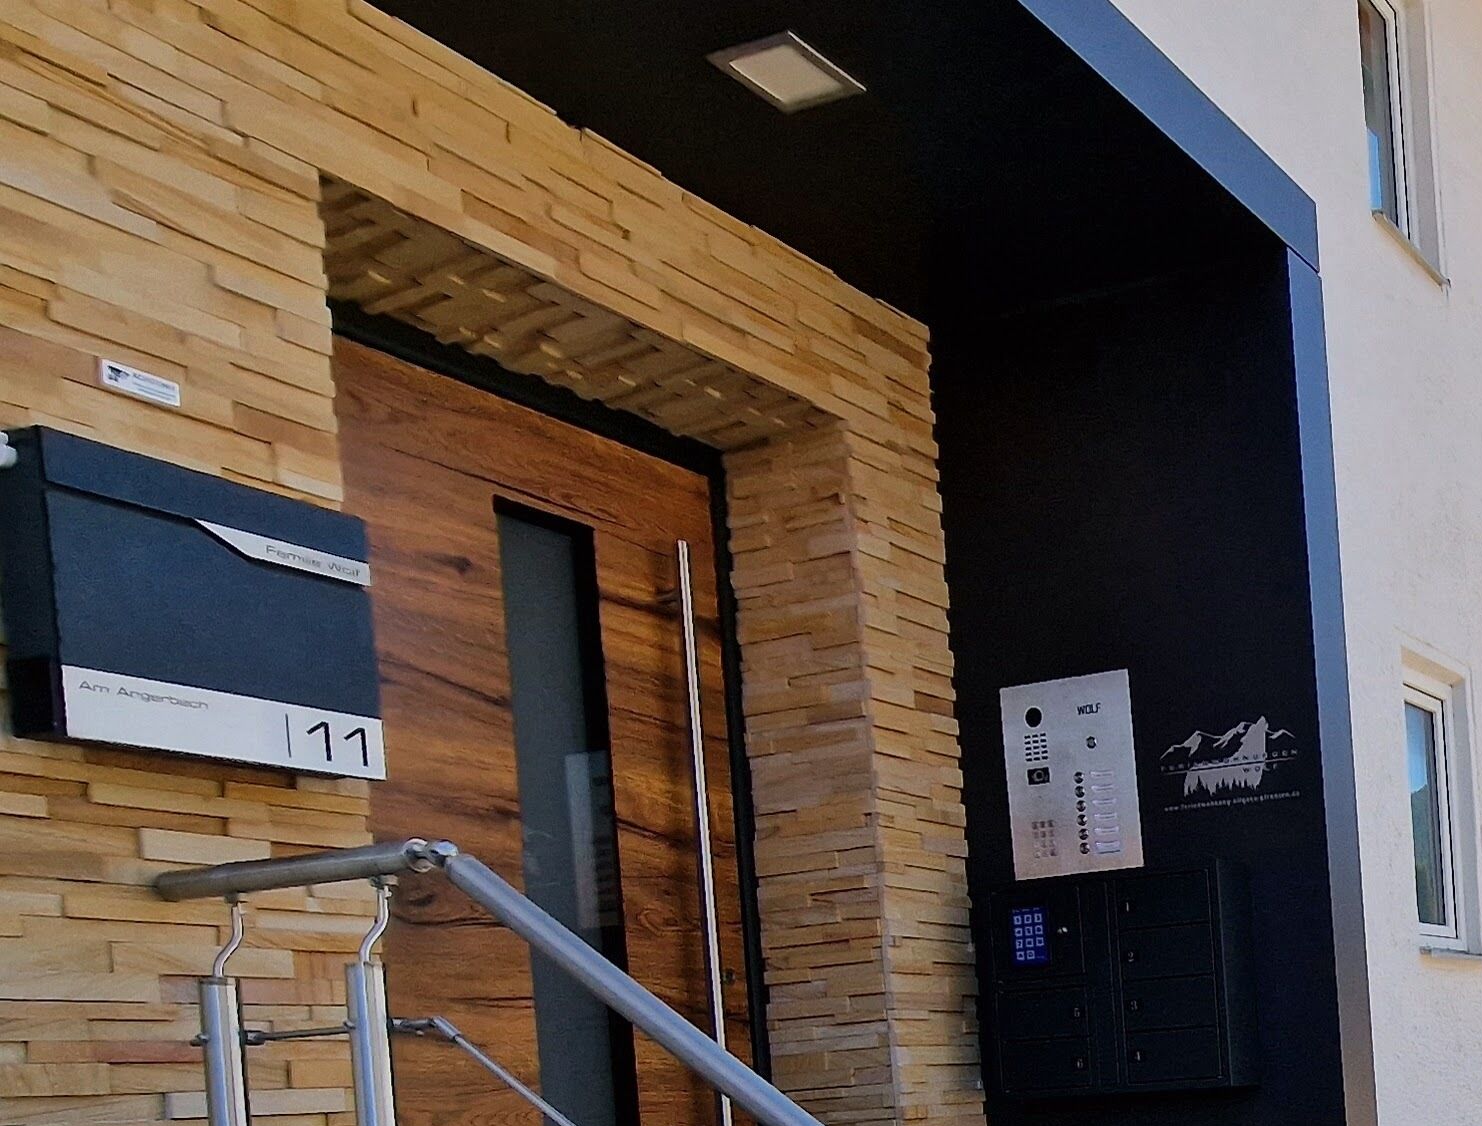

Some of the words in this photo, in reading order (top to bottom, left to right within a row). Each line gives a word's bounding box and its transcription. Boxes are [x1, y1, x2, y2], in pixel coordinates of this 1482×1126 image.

[79, 680, 110, 694] Am
[1076, 702, 1102, 716] WOLF
[306, 721, 369, 768] 11
